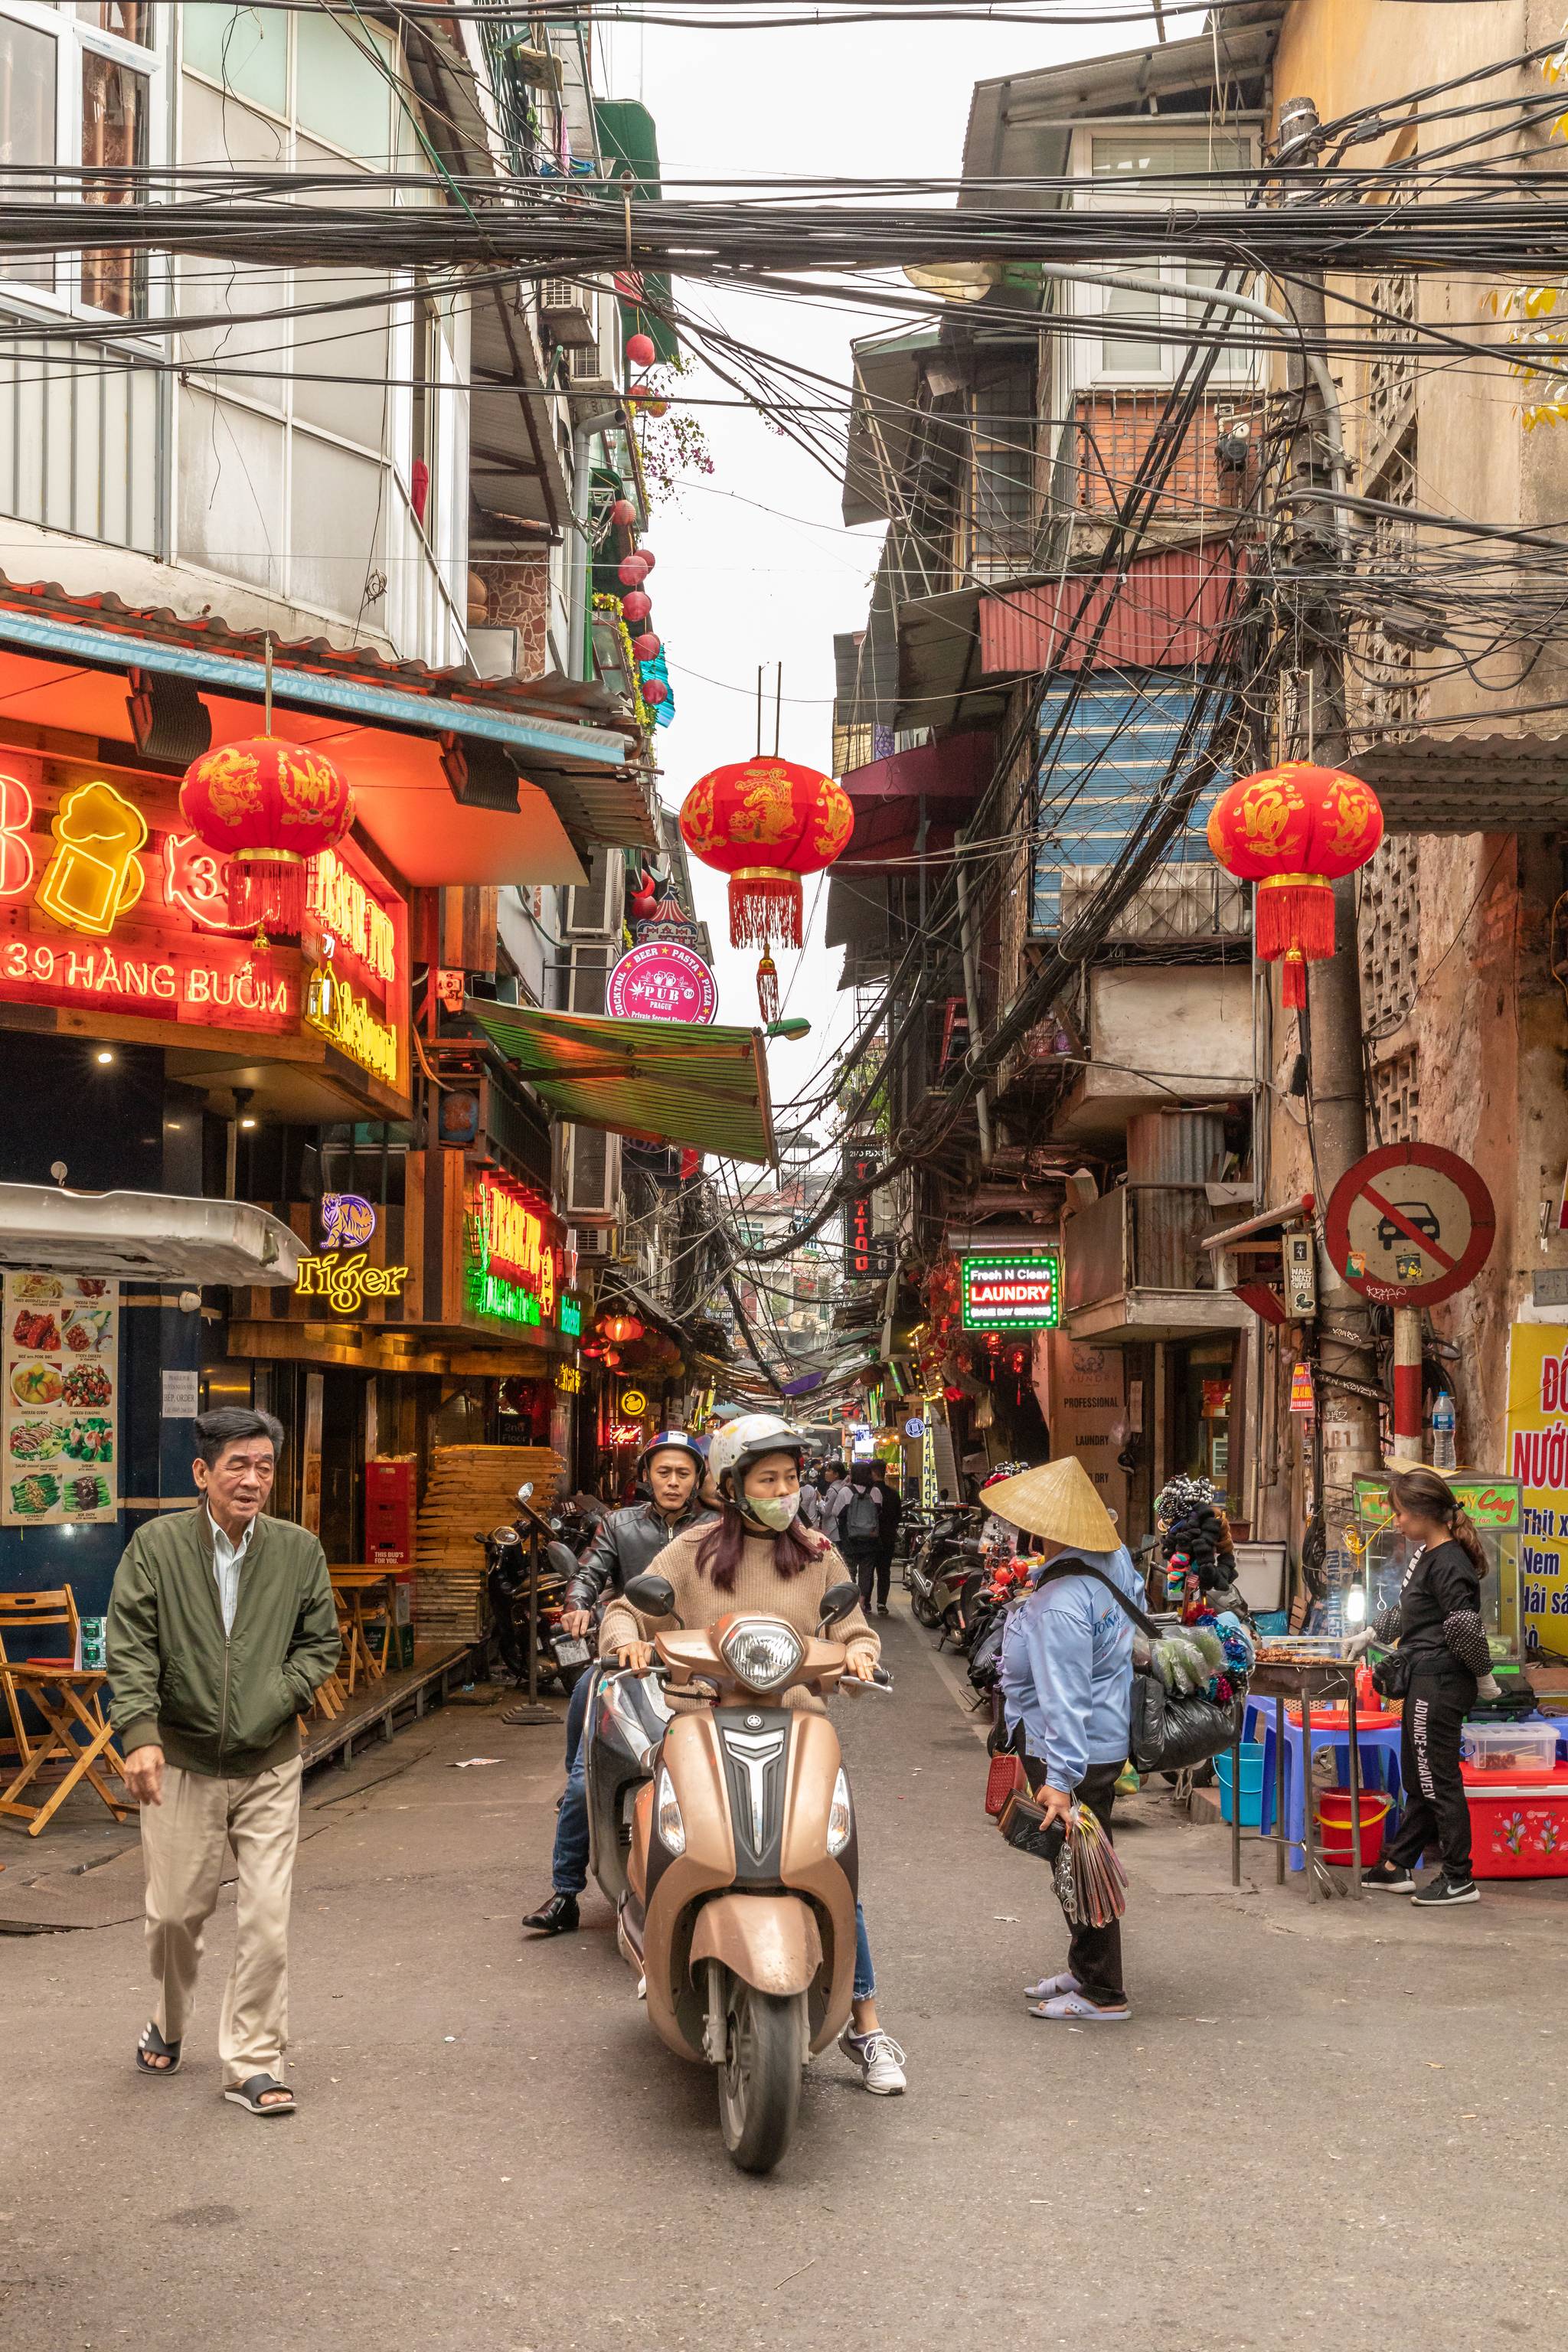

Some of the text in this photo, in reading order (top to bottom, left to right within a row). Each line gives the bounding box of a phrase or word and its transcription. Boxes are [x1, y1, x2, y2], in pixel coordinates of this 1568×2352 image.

[633, 948, 658, 963] BEER
[671, 949, 700, 972] PASTA
[8, 942, 54, 980] 39
[67, 946, 175, 997] HÀNG
[613, 972, 626, 1016] COCKTAIL
[644, 985, 679, 1001] PUB
[701, 978, 712, 1006] PIZZA
[631, 1011, 651, 1020] Private
[649, 1001, 672, 1011] PRAGUE
[853, 1162, 869, 1271] TTTOO
[296, 1253, 410, 1314] Tiger
[970, 1269, 1050, 1281] Fresh N Clean
[971, 1285, 1050, 1302] LAUNDRY
[1063, 1396, 1119, 1409] PROFESSIONAL
[1076, 1435, 1109, 1446] LAUNDRY
[1095, 1473, 1109, 1483] DRY
[1523, 1508, 1554, 1542] Thịt
[1524, 1547, 1560, 1575] Nem
[1413, 1698, 1436, 1800] ADVANCE BRAVELY
